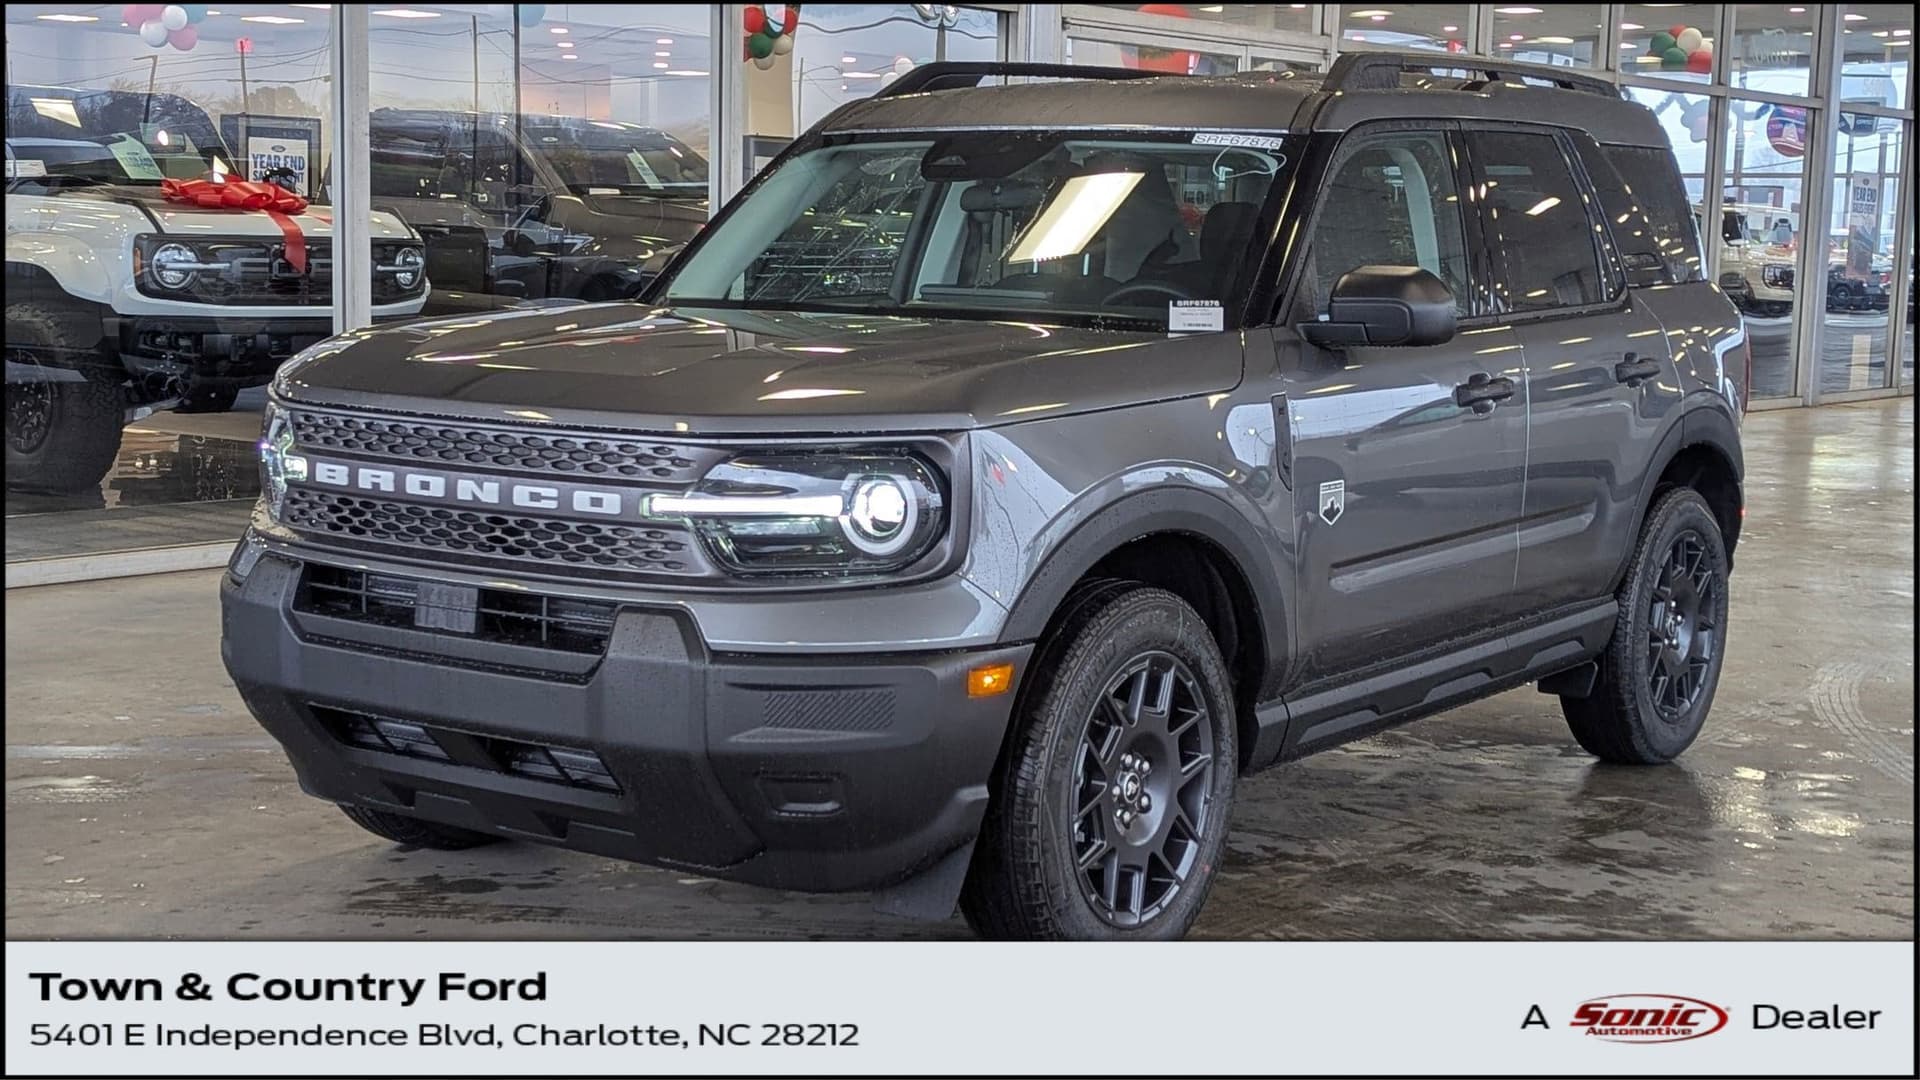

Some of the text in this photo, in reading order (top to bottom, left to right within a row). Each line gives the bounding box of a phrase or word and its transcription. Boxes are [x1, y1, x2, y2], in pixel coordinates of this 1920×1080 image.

[1194, 134, 1281, 148] SRF67876
[251, 153, 305, 171] YEAR END
[315, 462, 622, 515] BRONCO
